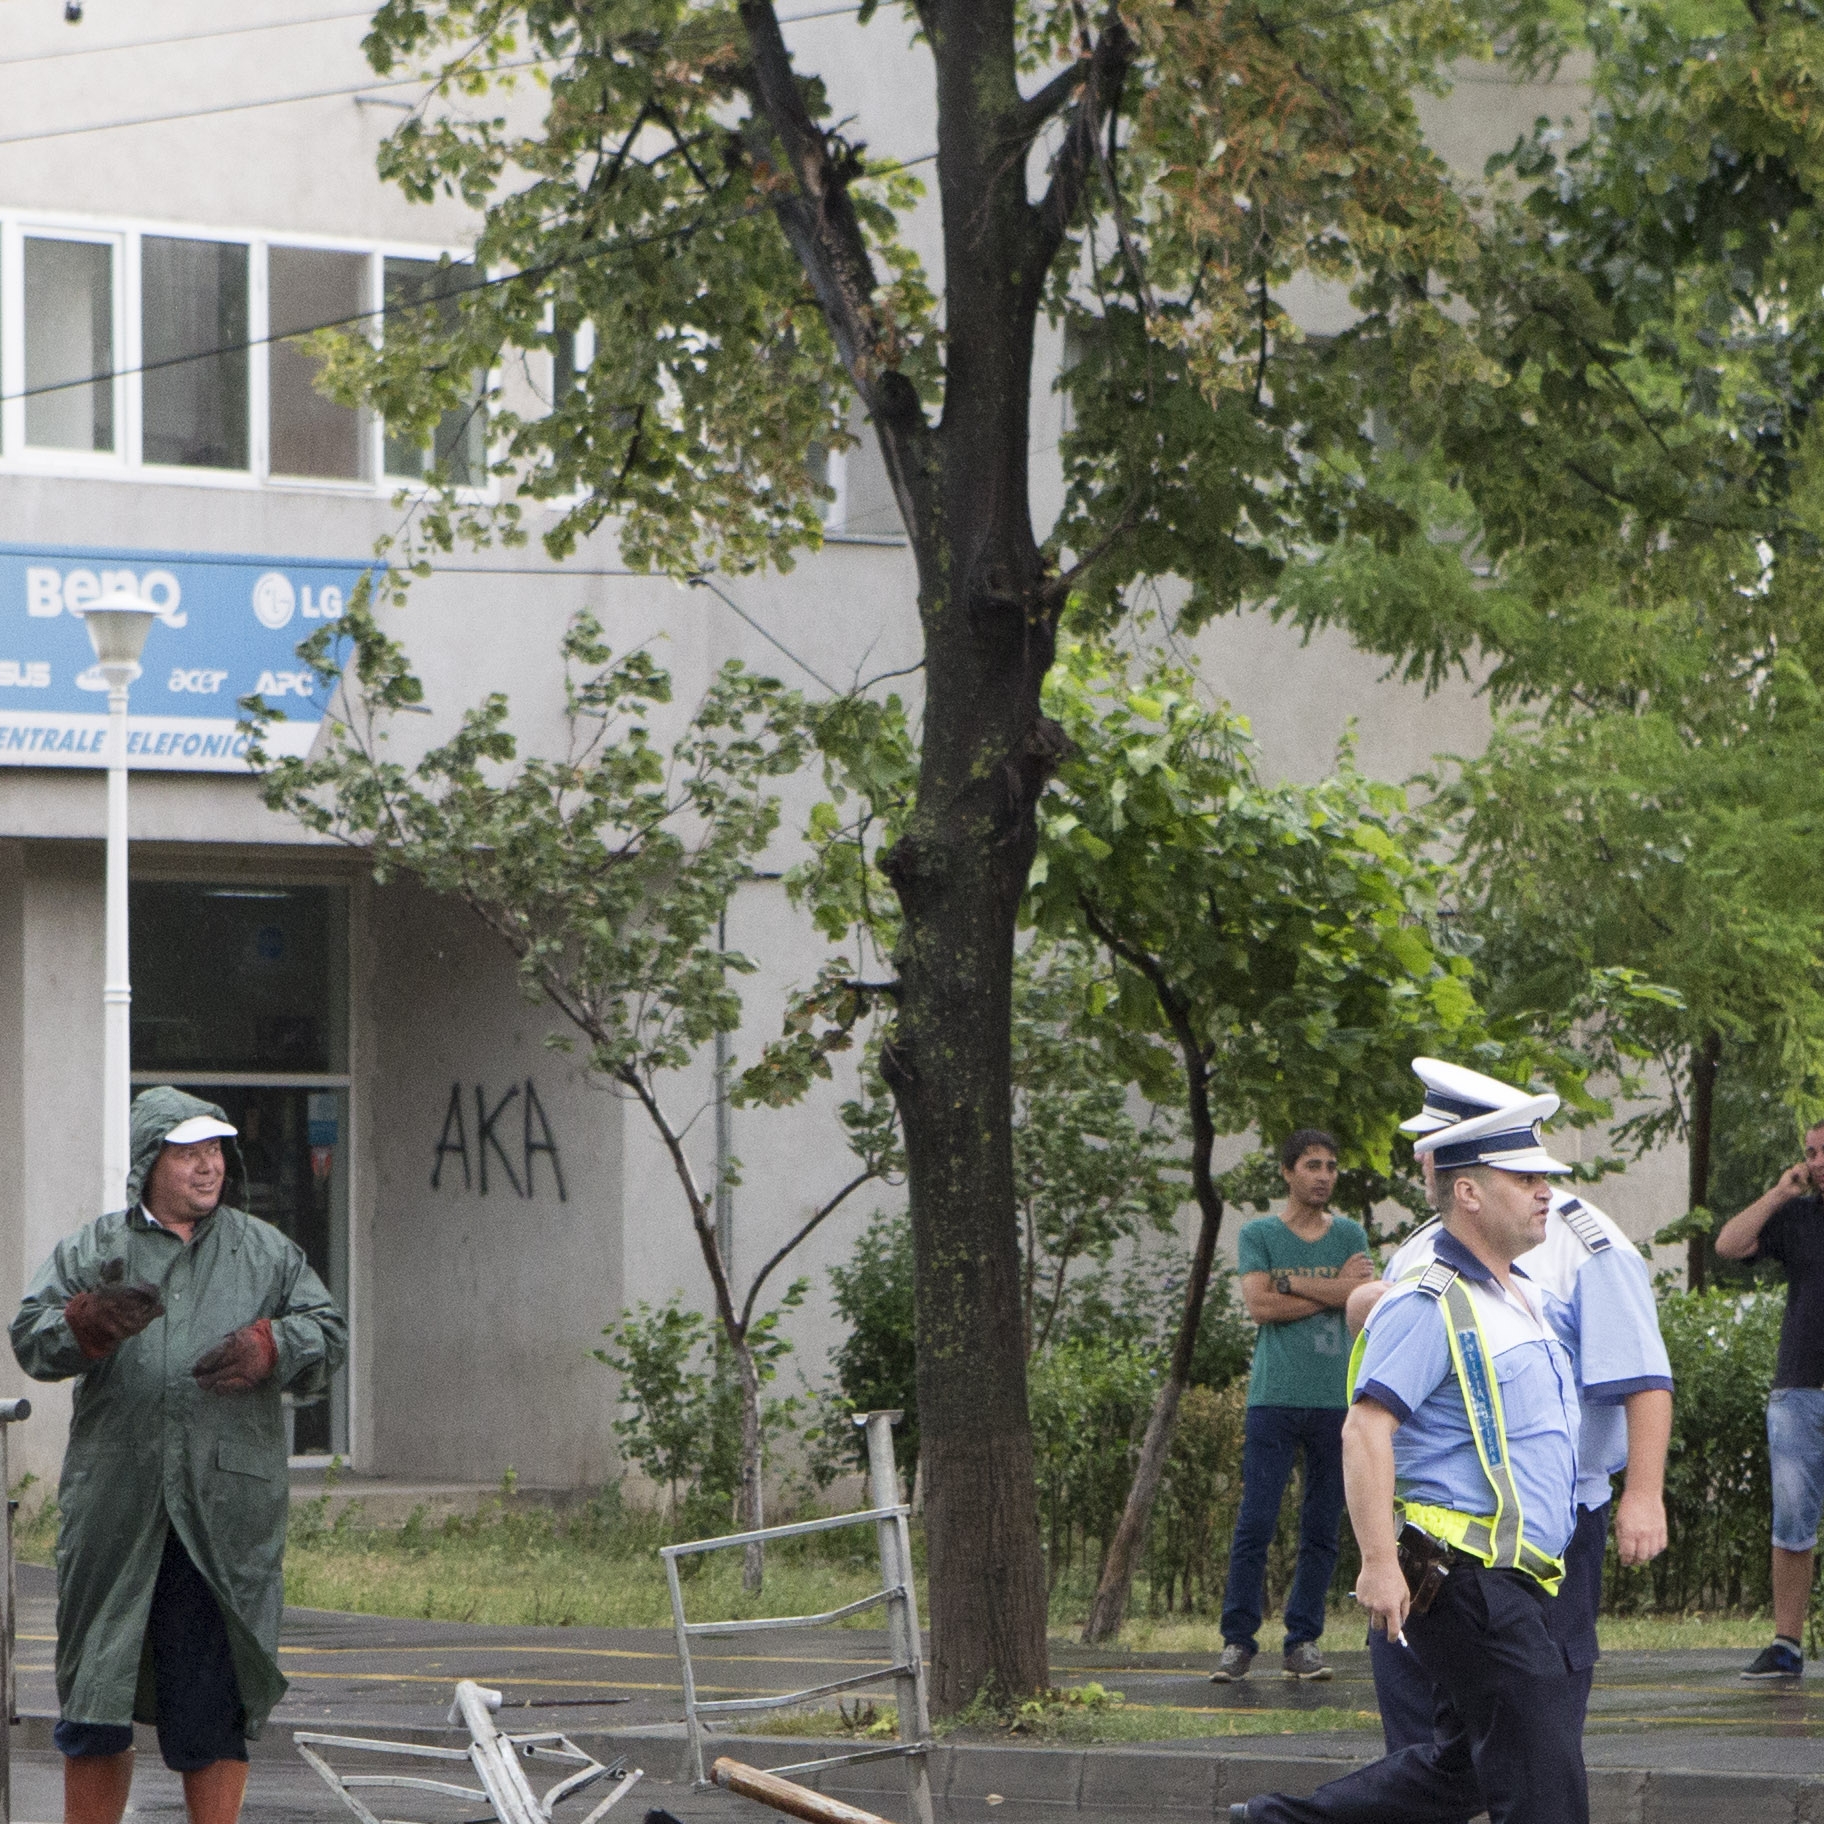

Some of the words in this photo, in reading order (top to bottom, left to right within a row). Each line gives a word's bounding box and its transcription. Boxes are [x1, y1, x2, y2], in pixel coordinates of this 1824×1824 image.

[301, 585, 343, 618] LG
[168, 670, 228, 694] acer
[253, 671, 313, 697] APC
[430, 1077, 568, 1203] AKA
